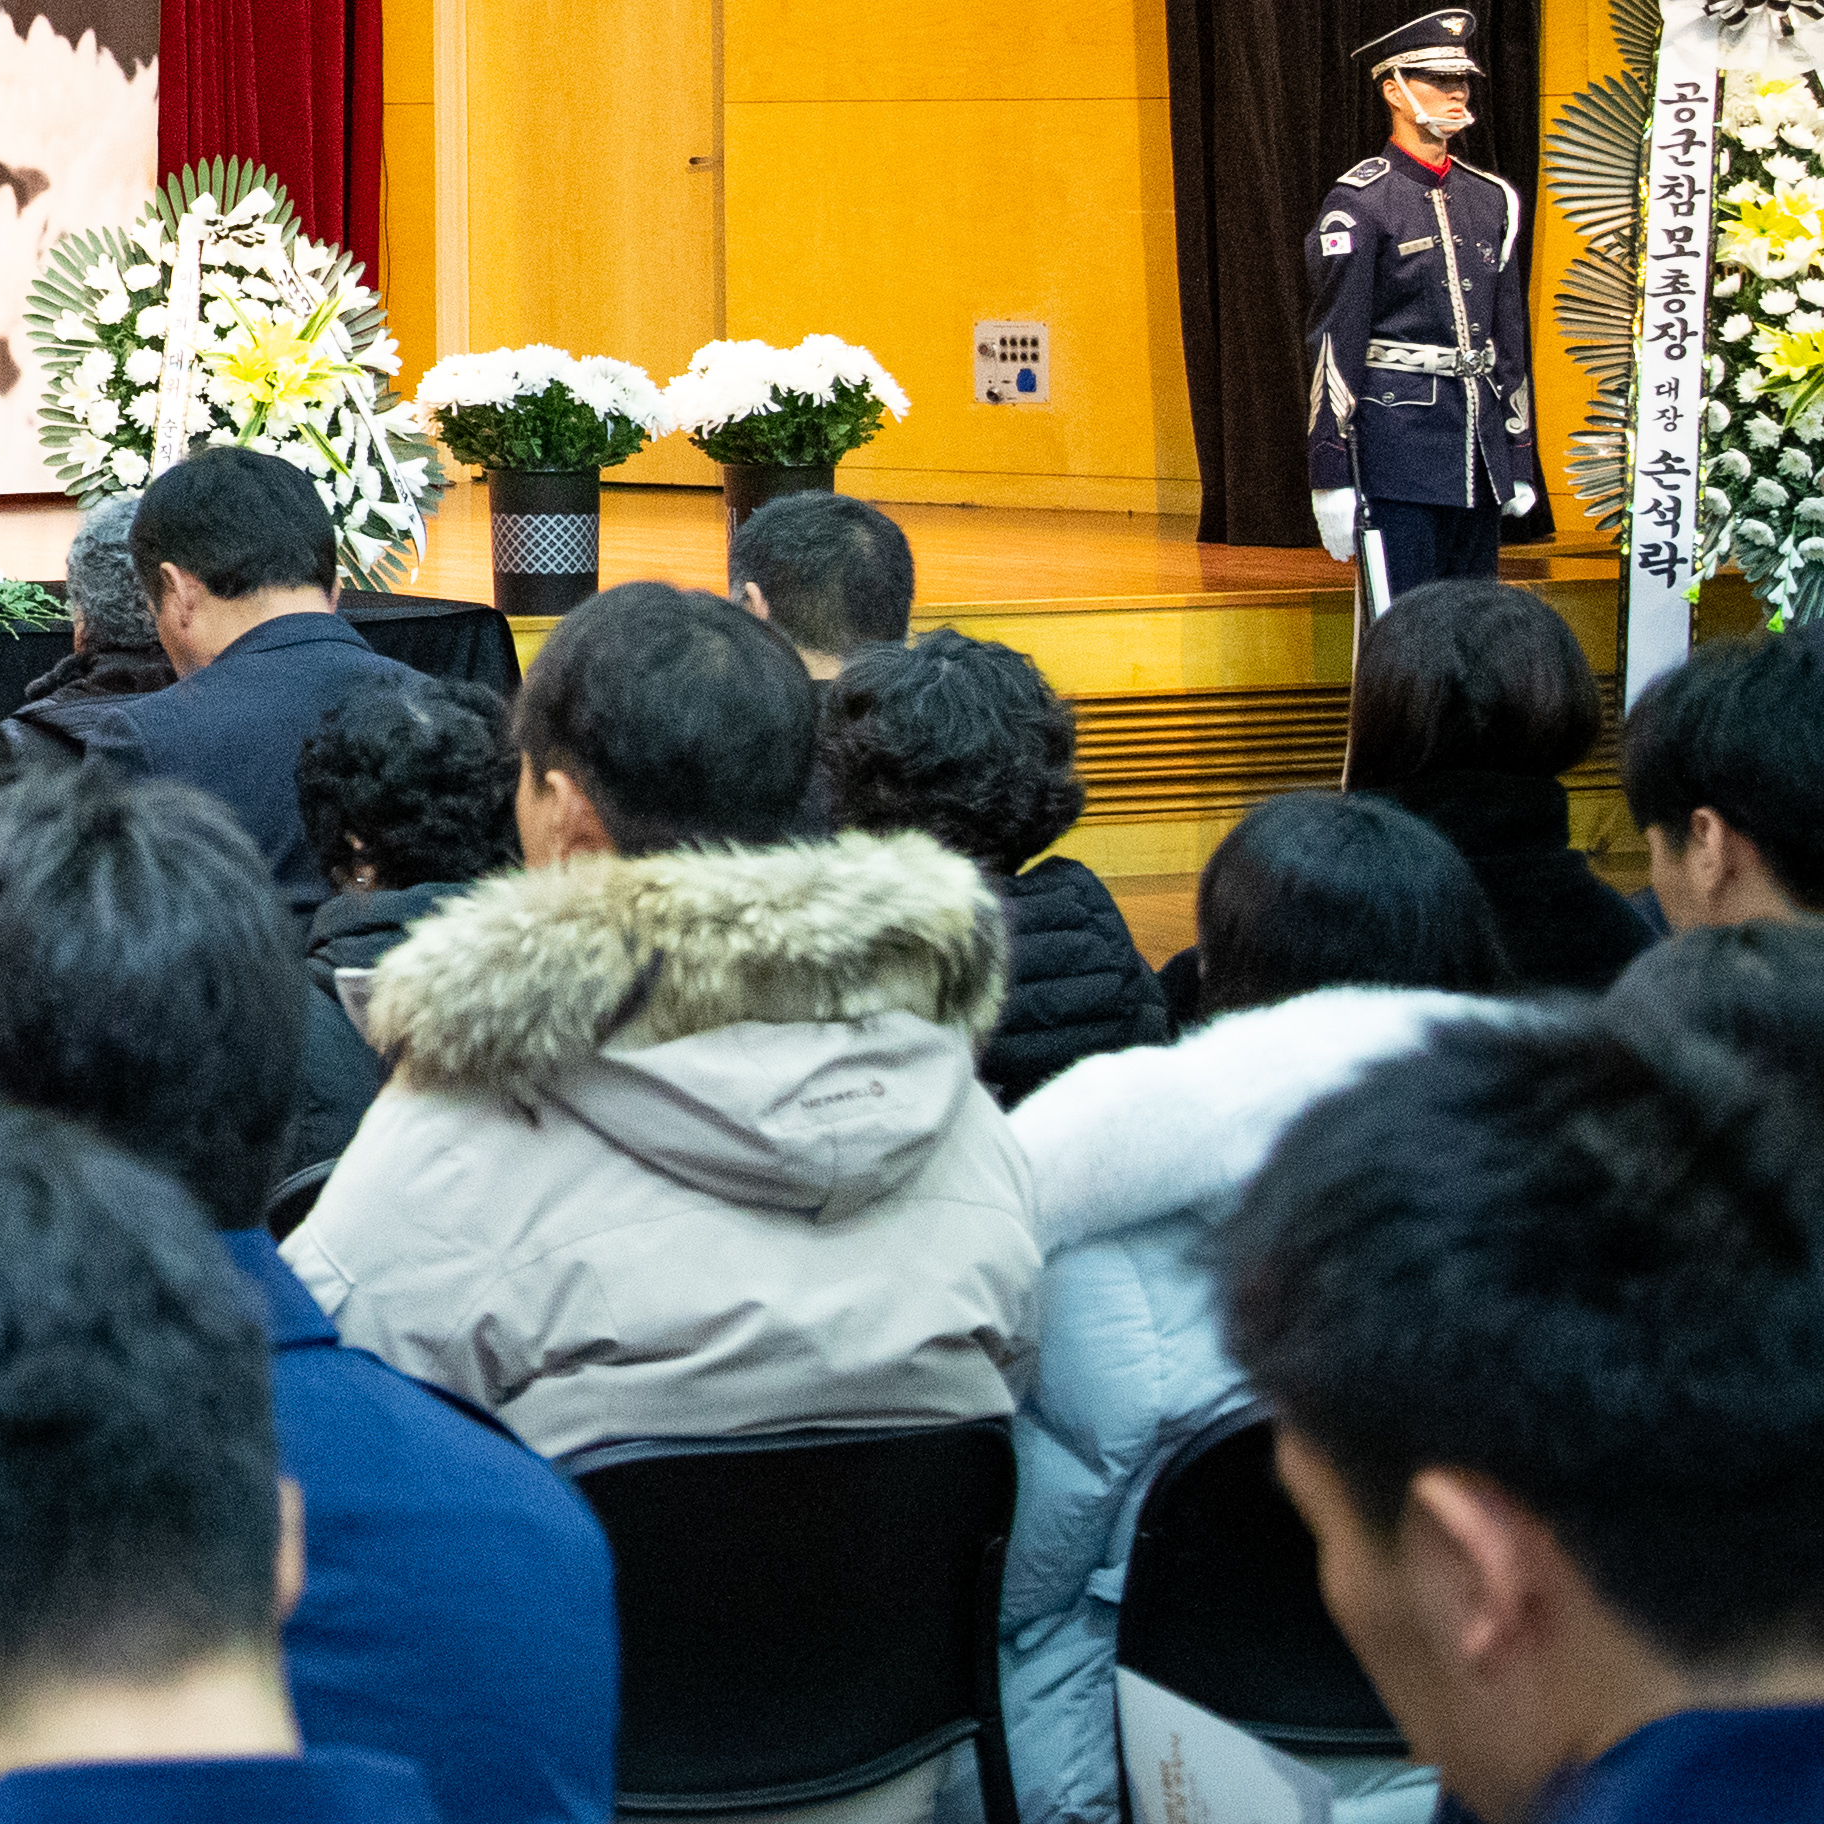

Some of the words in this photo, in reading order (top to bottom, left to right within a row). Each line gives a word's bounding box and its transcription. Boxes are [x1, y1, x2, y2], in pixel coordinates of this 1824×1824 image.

[1645, 81, 1709, 361] 공군참모총장
[164, 348, 184, 400] 대위
[1652, 376, 1685, 433] 대장
[1638, 449, 1692, 589] 손석락
